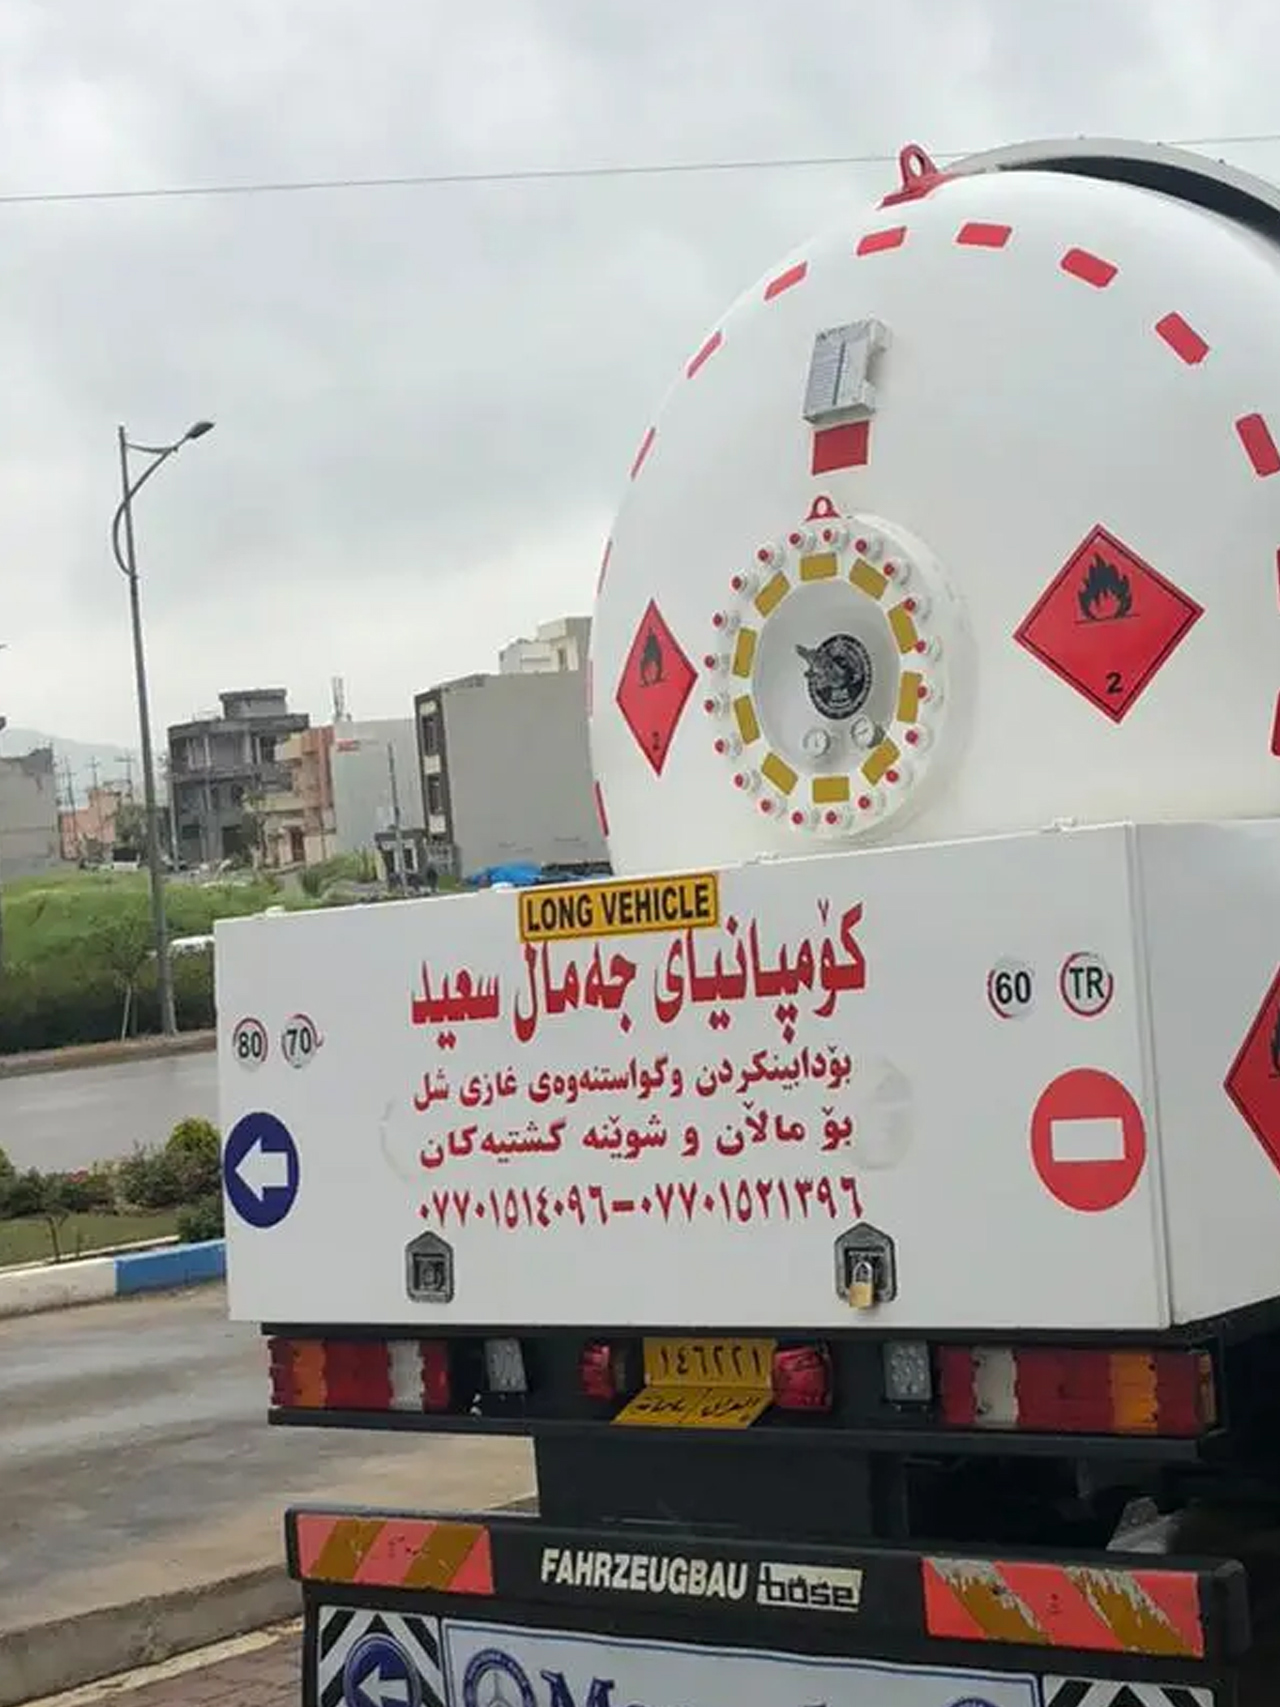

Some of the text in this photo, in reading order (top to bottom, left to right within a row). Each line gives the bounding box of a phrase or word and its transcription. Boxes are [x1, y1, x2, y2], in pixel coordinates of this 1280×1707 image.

[1106, 672, 1123, 695] 2
[527, 884, 709, 931] LONG VEHICLE
[995, 971, 1031, 1004] 60
[1068, 963, 1105, 1000] TR
[238, 1031, 262, 1058] 80
[286, 1026, 311, 1056] 70
[681, 1126, 700, 1156] و
[541, 1548, 748, 1600] FAHRZEUGBAU
